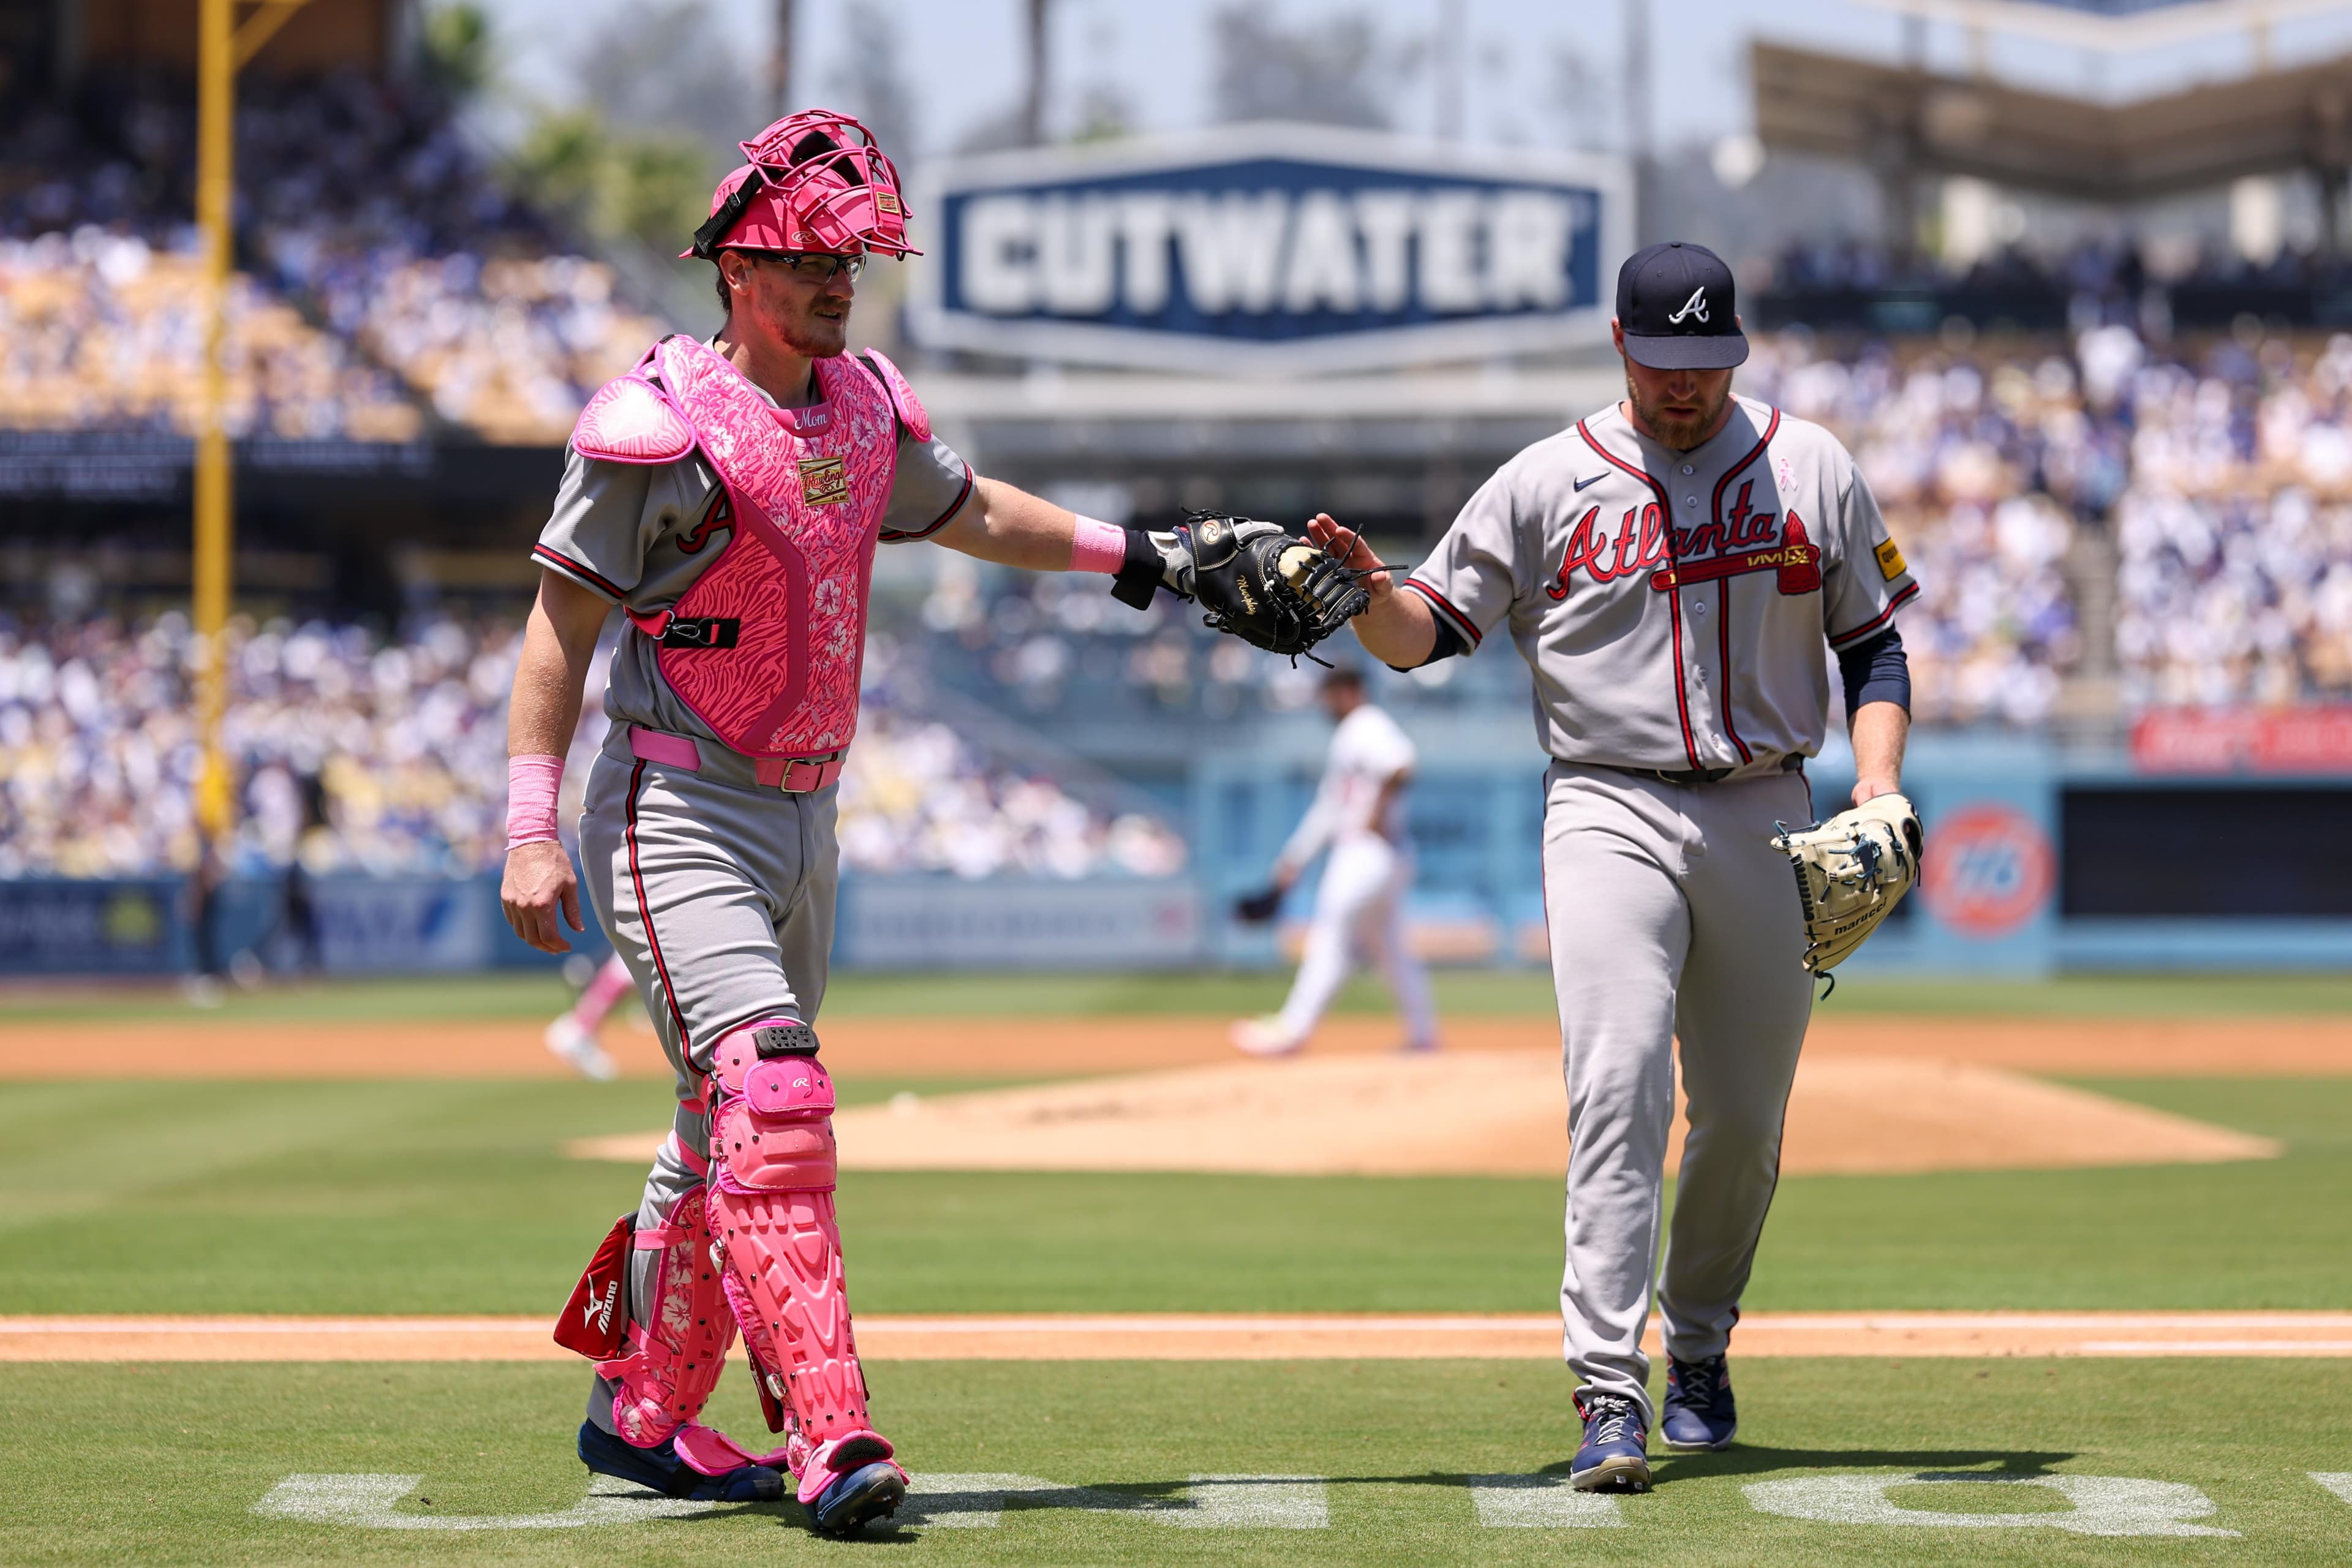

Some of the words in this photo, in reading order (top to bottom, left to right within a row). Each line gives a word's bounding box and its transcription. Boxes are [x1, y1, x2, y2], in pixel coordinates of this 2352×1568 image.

[959, 189, 1573, 316] CUTWATER
[1668, 285, 1710, 325] A
[794, 409, 827, 430] Mom
[804, 469, 843, 491] Rawlings
[1545, 478, 1777, 600] Atlanta
[1236, 575, 1258, 616] Murphy
[1834, 897, 1888, 935] marucci
[597, 1280, 618, 1336] MIZUNO
[249, 1471, 2352, 1537] UNIQ
